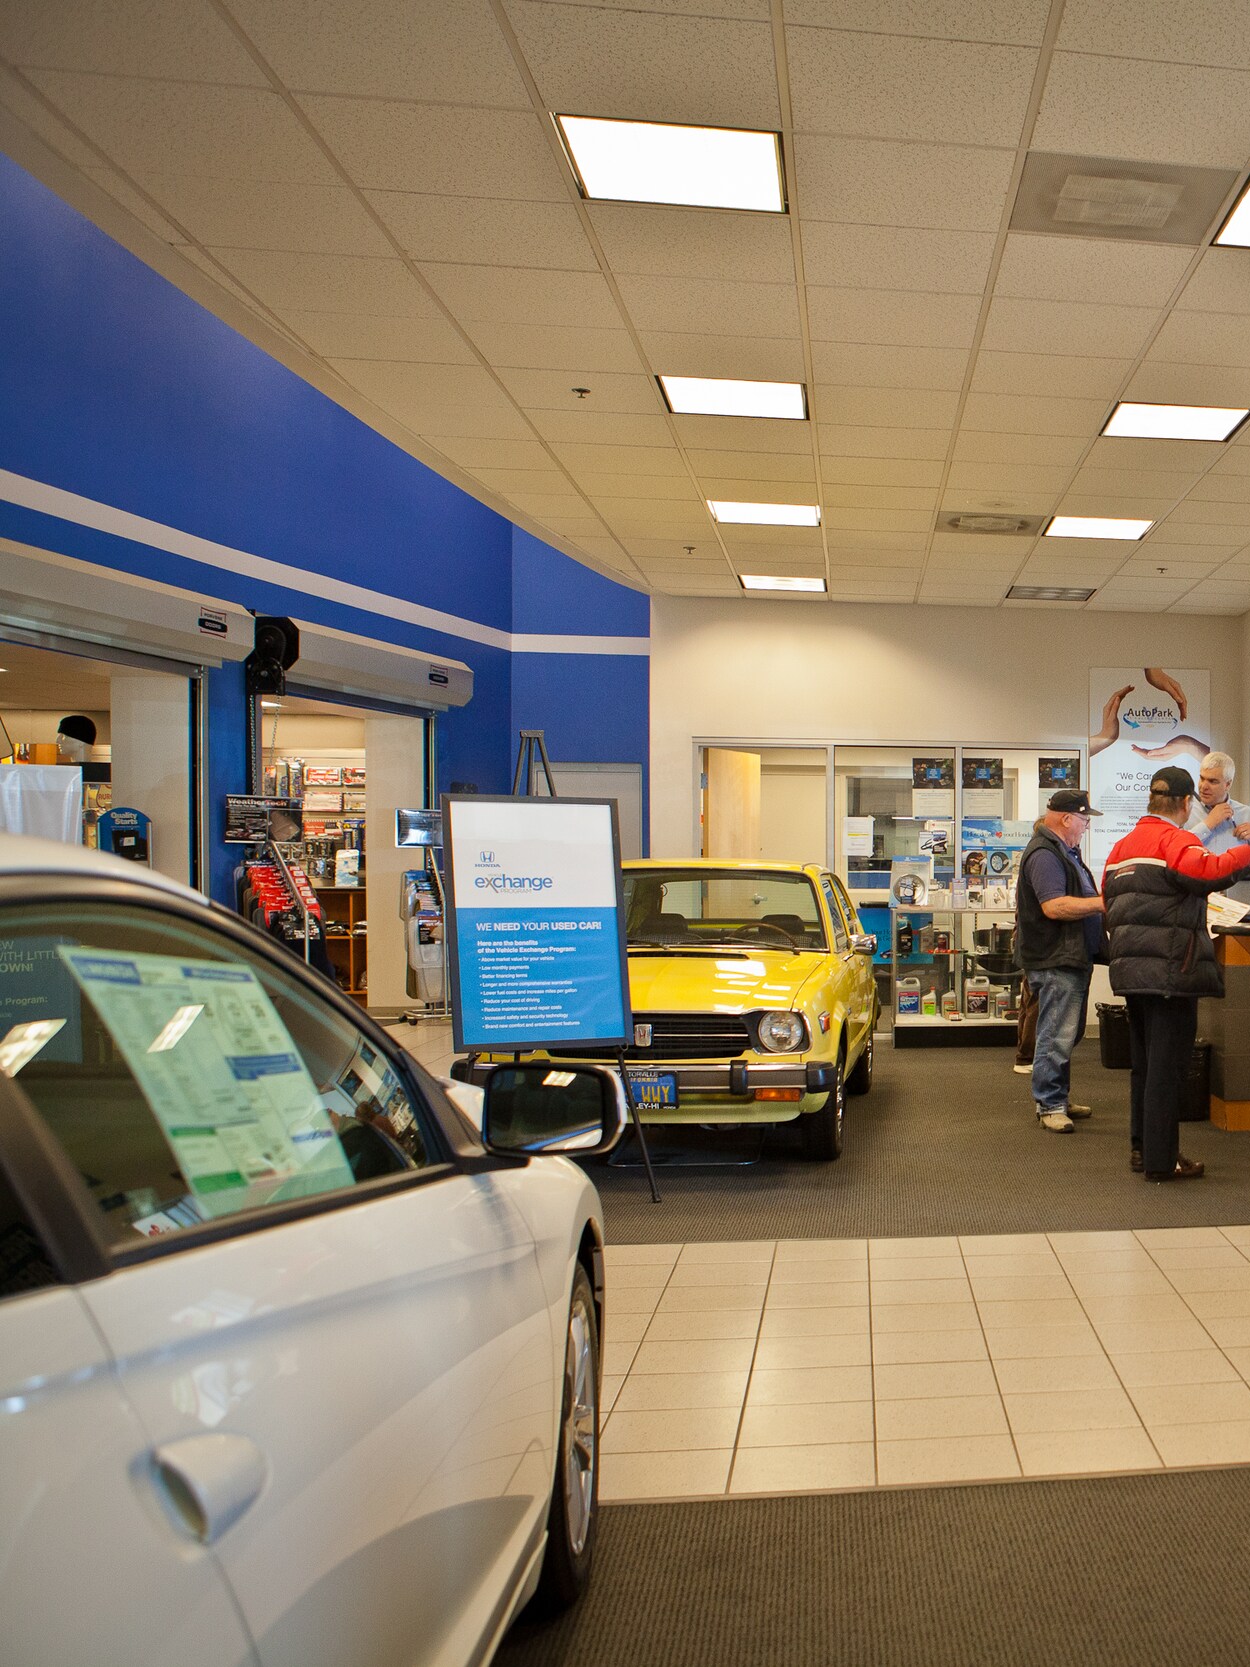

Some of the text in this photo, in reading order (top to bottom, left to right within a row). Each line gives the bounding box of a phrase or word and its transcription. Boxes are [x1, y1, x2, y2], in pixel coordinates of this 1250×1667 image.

[1127, 708, 1173, 718] AutoPark
[1136, 772, 1152, 780] Car
[1115, 783, 1131, 791] Our
[228, 798, 288, 807] WeatherTech
[111, 812, 138, 820] Quality
[475, 874, 553, 893] exchange
[476, 921, 602, 931] WE NEED YOUR USED CAR!
